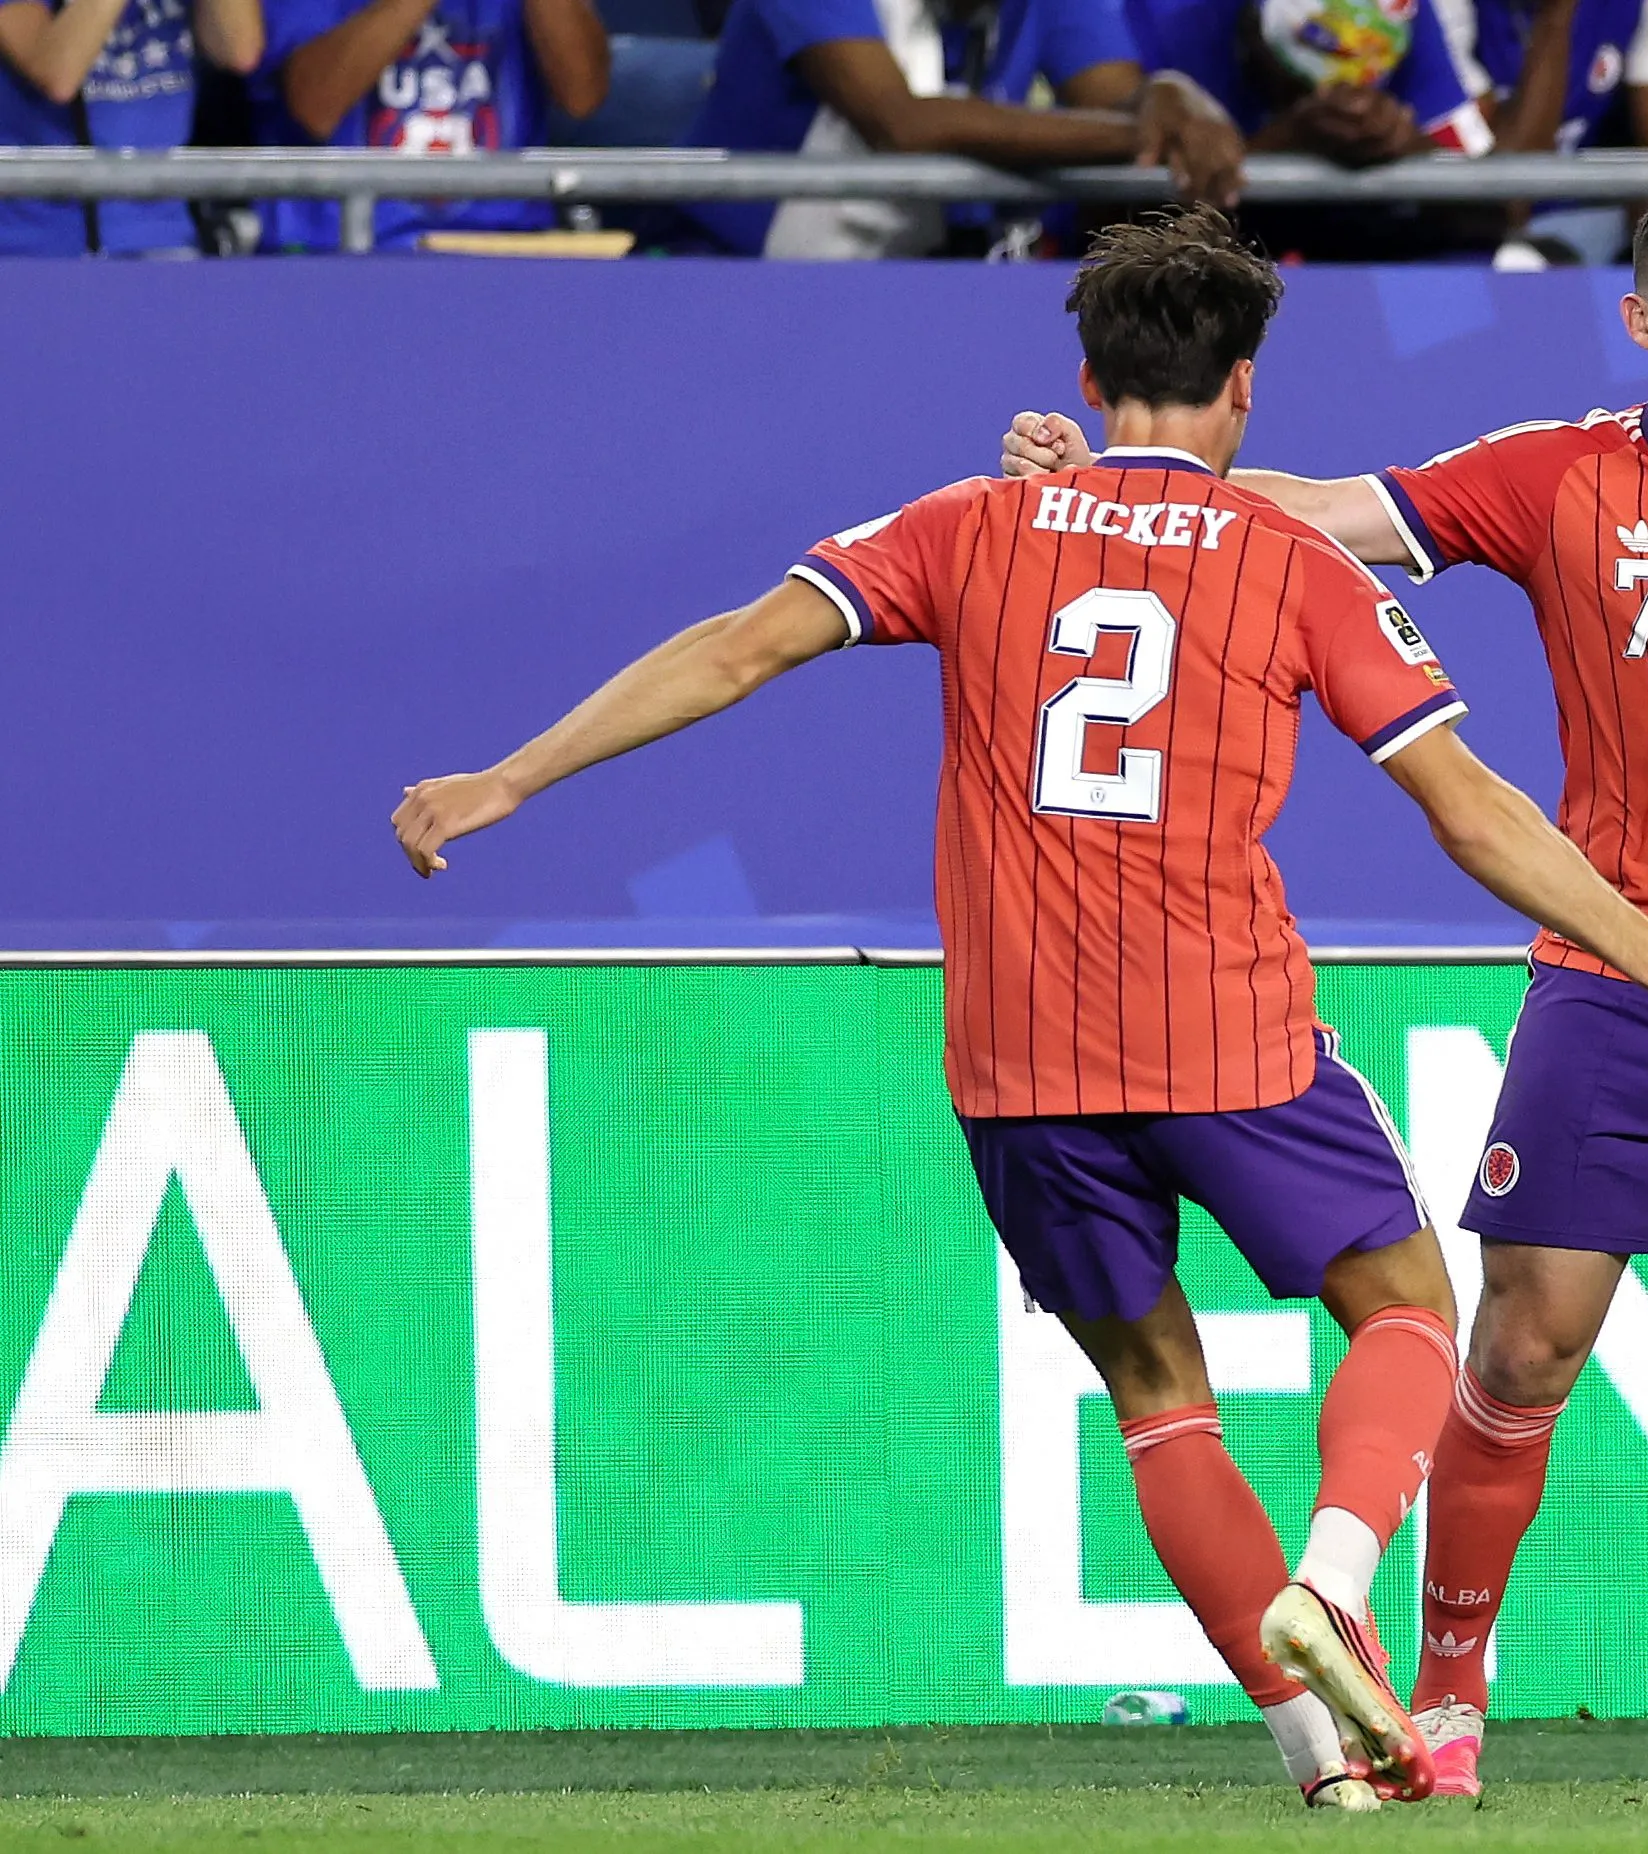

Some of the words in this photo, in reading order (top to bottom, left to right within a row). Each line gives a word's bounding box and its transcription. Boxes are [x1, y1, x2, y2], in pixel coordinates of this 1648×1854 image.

[378, 61, 492, 111] USA
[1032, 486, 1238, 550] HICKEY
[1032, 586, 1178, 824] 2
[0, 1027, 806, 1694] AL
[1426, 1580, 1491, 1606] ALBA
